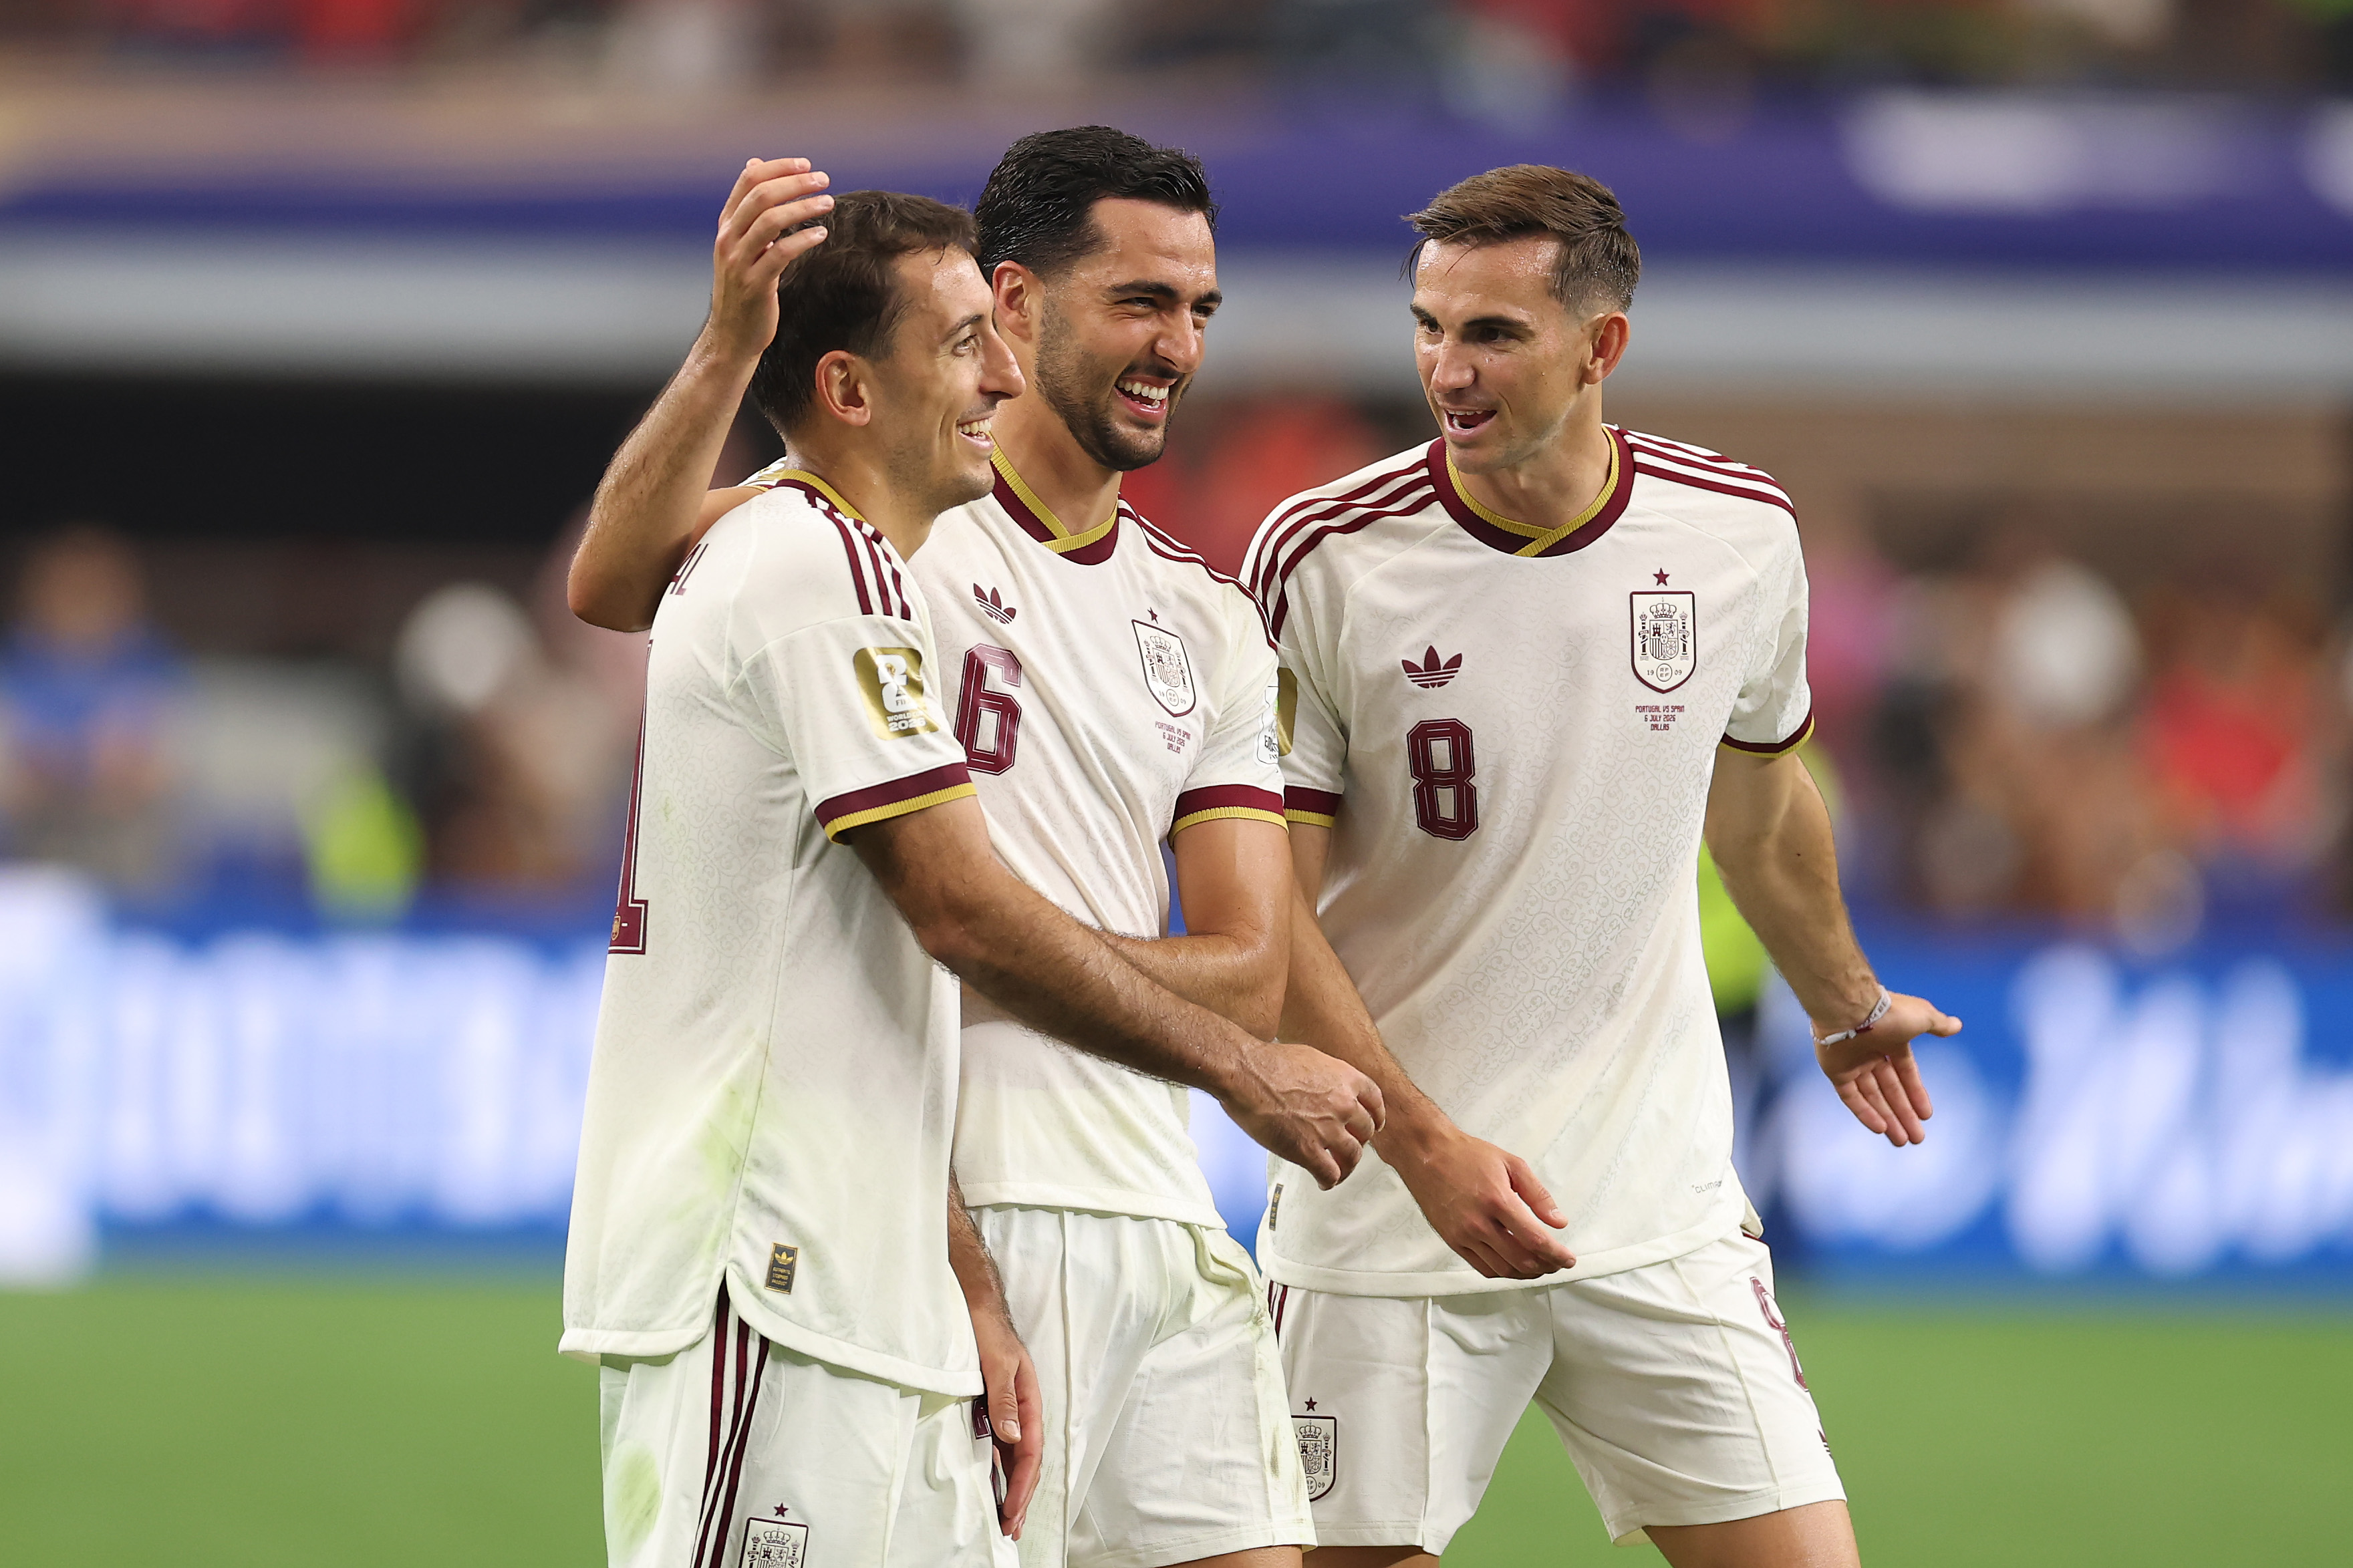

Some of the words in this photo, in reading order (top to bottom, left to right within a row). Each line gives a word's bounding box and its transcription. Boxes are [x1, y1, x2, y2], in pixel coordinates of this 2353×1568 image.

[954, 643, 1022, 776] 6
[887, 712, 912, 722] WORLD
[888, 717, 926, 732] 2026
[1155, 722, 1175, 734] PORTUGAL
[1167, 734, 1176, 743] JULY
[1167, 743, 1180, 754] DALLAS
[1407, 718, 1478, 841] 8
